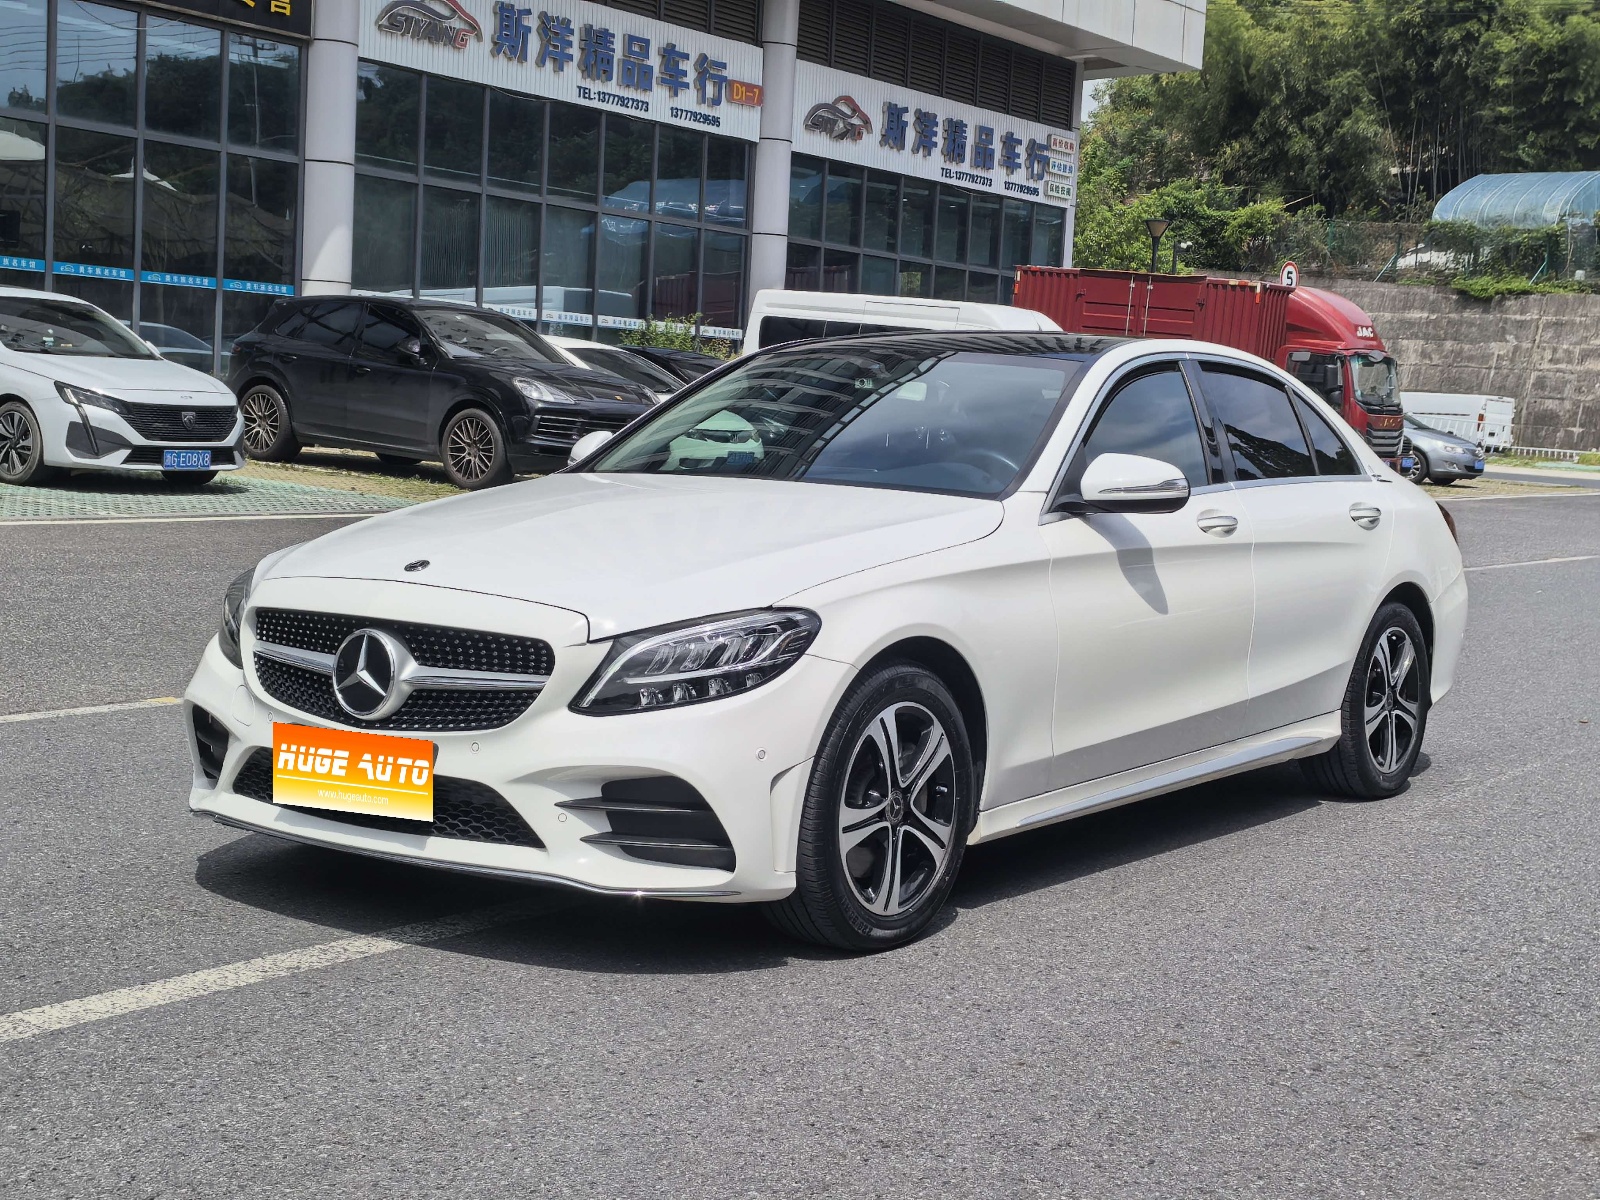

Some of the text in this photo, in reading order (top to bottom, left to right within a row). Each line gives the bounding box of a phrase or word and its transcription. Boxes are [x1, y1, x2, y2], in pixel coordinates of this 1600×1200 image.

[491, 1, 728, 107] 斯洋精品车行
[732, 84, 760, 104] D1-7
[880, 101, 1049, 181] 斯洋精品车行
[1286, 270, 1294, 286] 5
[1356, 325, 1374, 338] JAC
